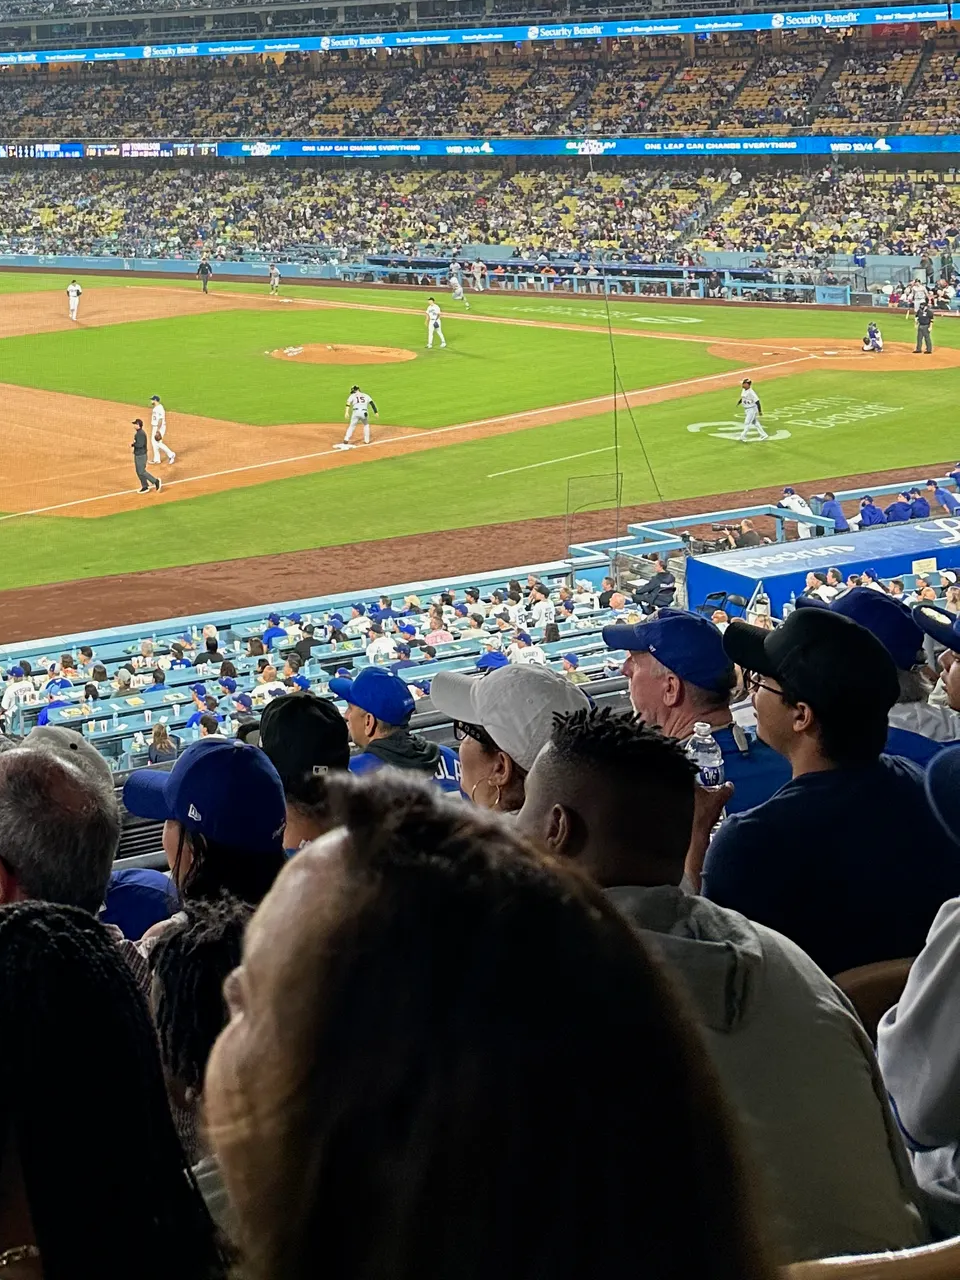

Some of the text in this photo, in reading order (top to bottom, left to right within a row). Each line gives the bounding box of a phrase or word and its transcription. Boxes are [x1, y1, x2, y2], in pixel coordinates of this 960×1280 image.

[786, 12, 858, 25] Security Benefit
[540, 25, 602, 38] Security Benefit
[330, 36, 383, 47] Security Benefit
[706, 142, 741, 150] CHANGE
[743, 141, 797, 149] EVERYTHING
[830, 143, 851, 152] WED
[724, 544, 856, 569] Spectrum
